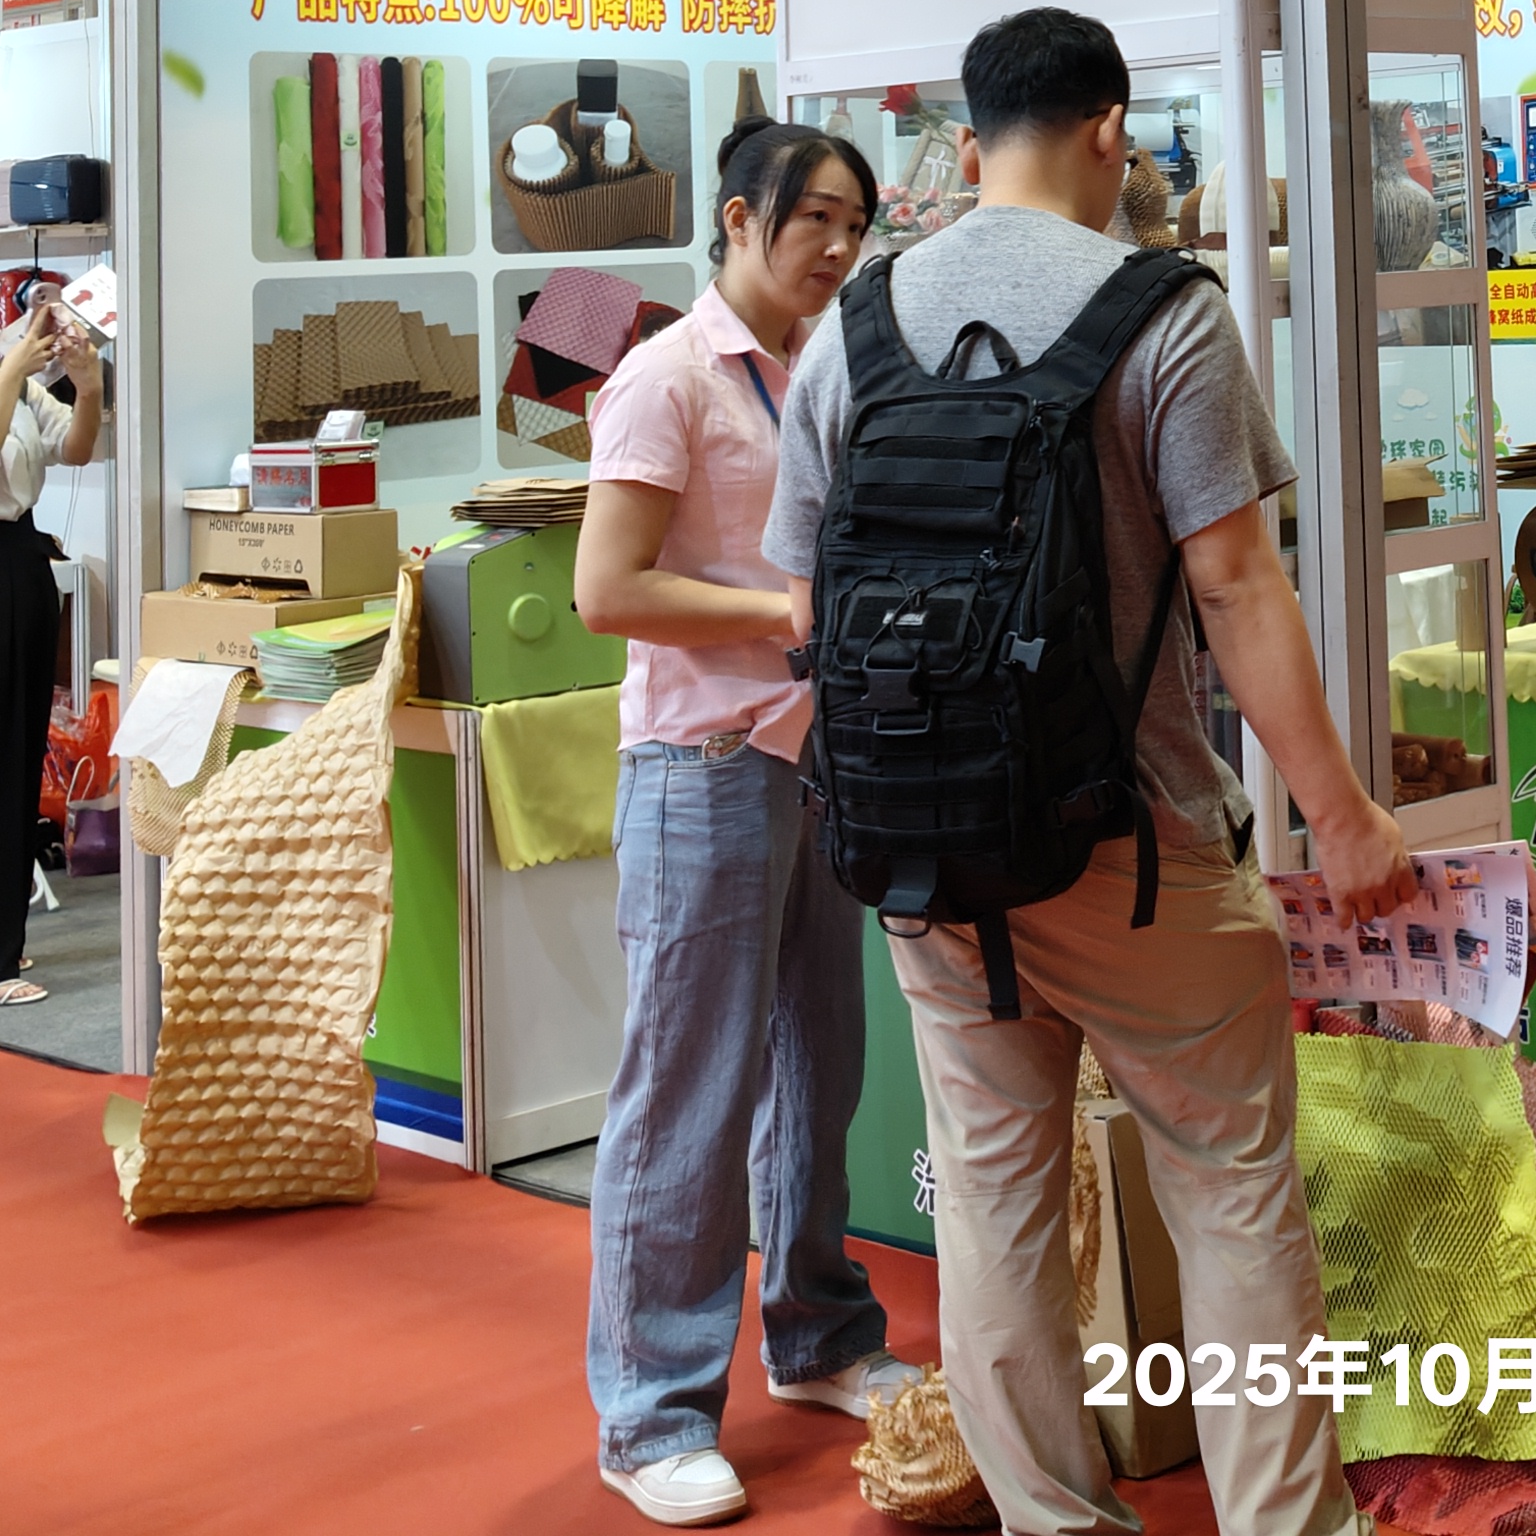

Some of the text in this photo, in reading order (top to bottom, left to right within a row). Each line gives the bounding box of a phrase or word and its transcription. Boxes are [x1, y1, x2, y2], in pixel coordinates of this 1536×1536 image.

[209, 519, 295, 537] HONEYCOMB PAPER
[1504, 896, 1524, 979] 爆品推荐
